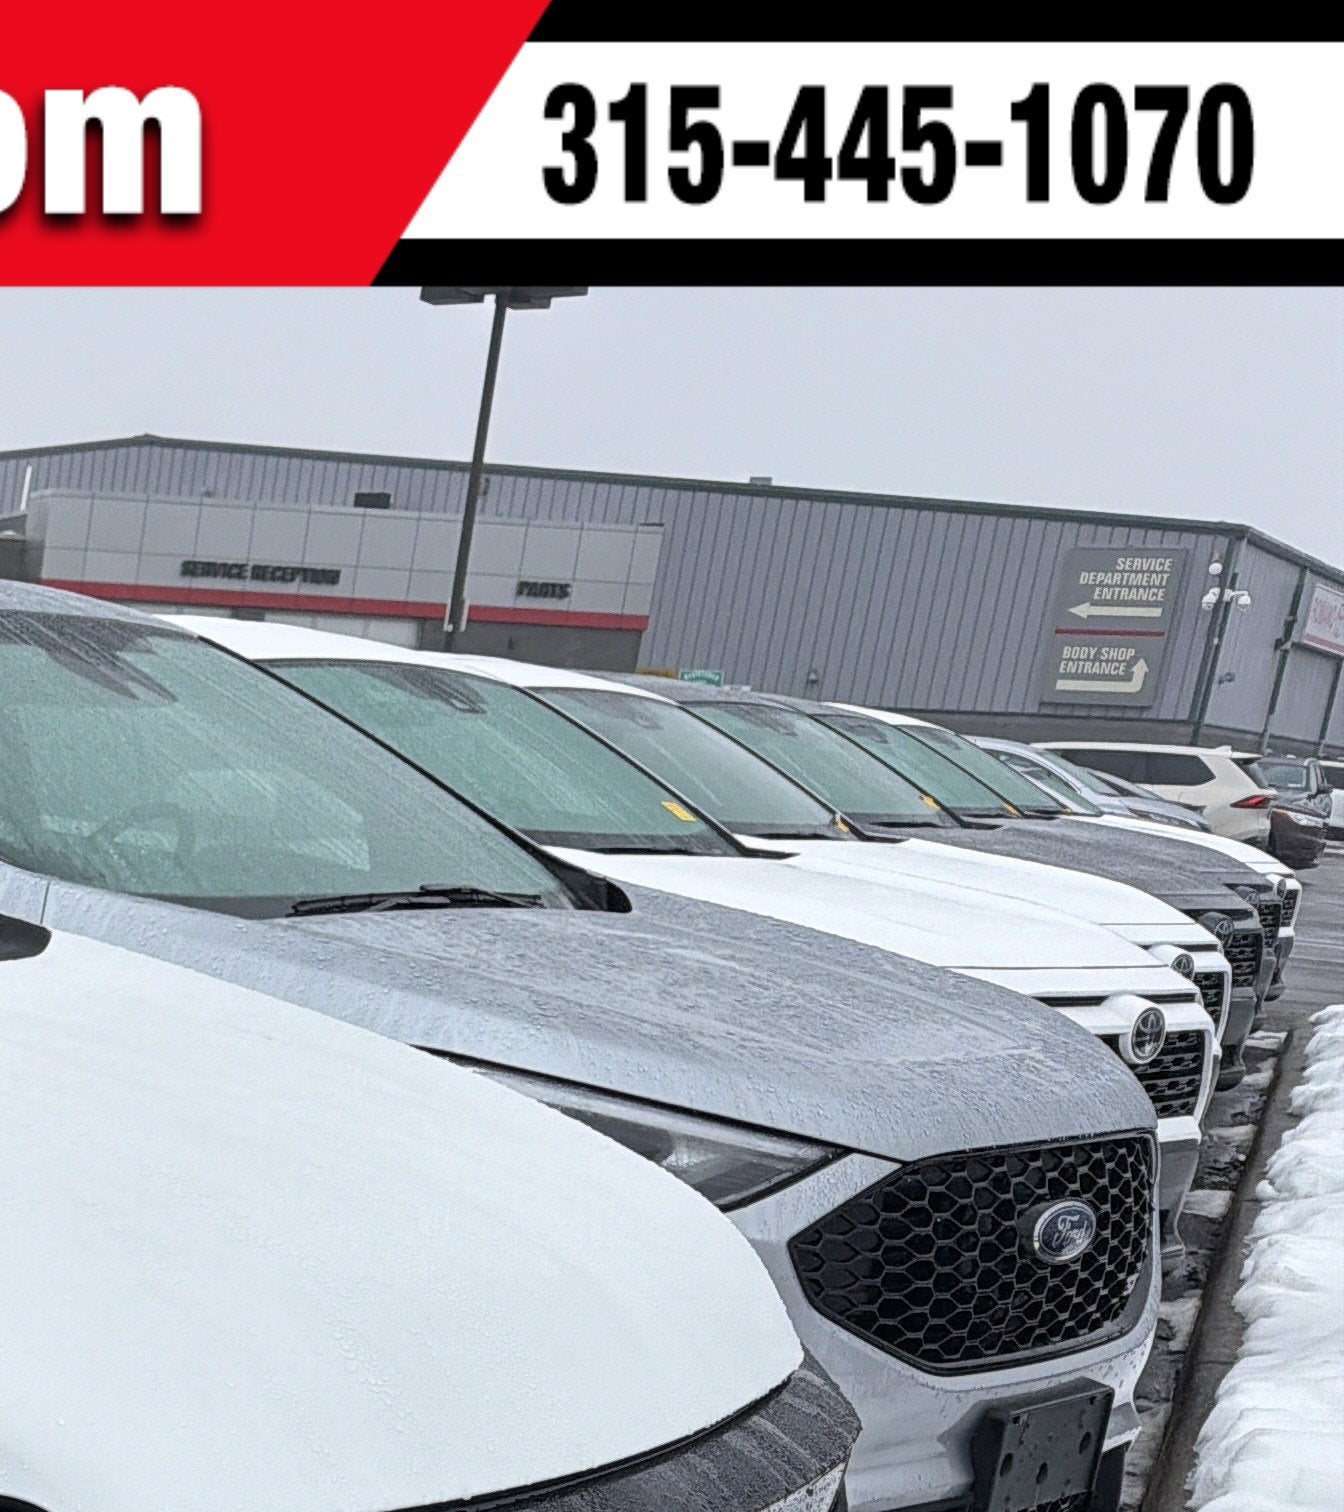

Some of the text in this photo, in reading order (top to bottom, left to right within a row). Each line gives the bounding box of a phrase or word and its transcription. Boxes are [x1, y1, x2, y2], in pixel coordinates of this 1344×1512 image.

[1116, 558, 1173, 572] SERVICE
[1079, 571, 1171, 586] DEPARTMENT
[1093, 586, 1167, 601] ENTRANCE
[1062, 645, 1136, 661] BODY SHOP
[1059, 660, 1127, 676] ENTRANCE
[1052, 1214, 1092, 1249] Ford
